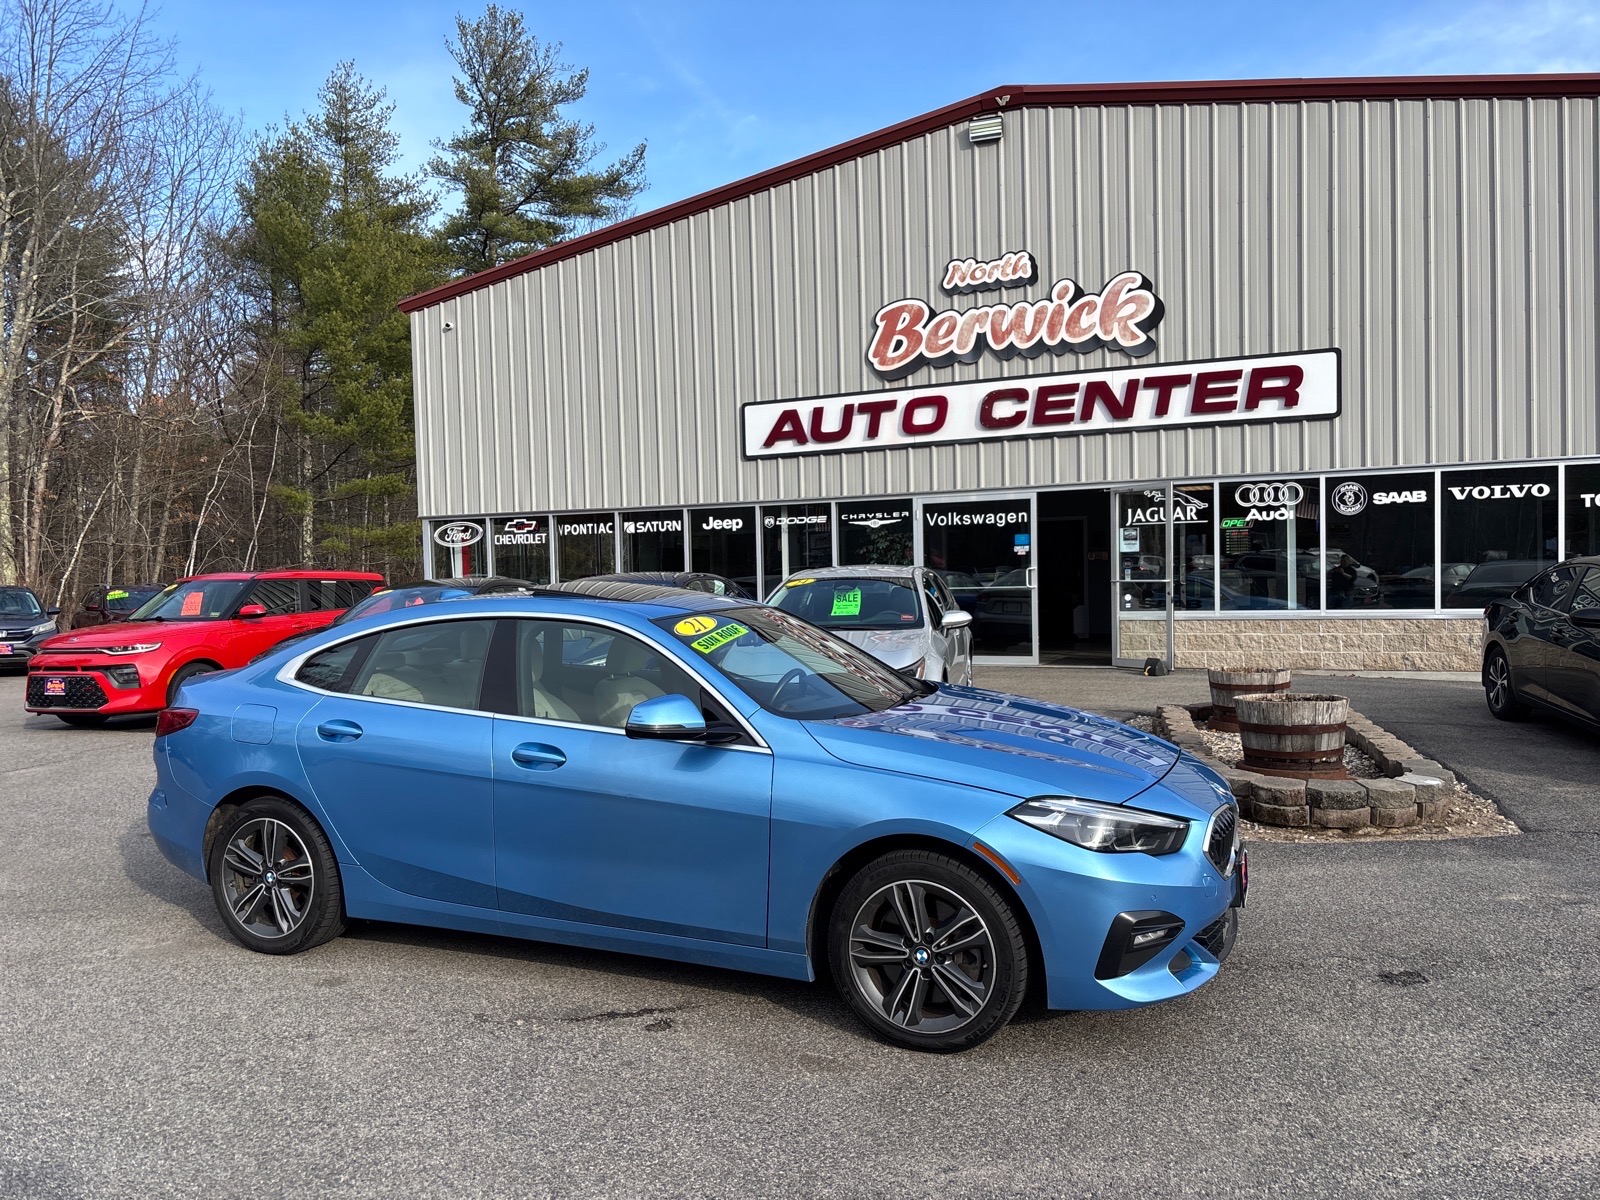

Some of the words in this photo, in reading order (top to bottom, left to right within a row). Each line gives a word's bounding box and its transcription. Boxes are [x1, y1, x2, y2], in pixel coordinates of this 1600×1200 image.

[943, 251, 1032, 291] North
[869, 271, 1152, 372] Berwick
[762, 395, 949, 447] AUTO
[980, 364, 1304, 429] CENTER
[1372, 490, 1427, 505] SAAB
[1448, 483, 1550, 500] VOLVO
[776, 515, 828, 525] DODGE
[841, 511, 909, 520] CHRYSLER
[926, 511, 1028, 527] Volkswagen
[1245, 507, 1294, 521] Audi
[564, 522, 613, 536] PONTIAC
[636, 520, 682, 533] SATURN
[702, 516, 743, 531] Jeep
[444, 526, 472, 541] Ford
[494, 533, 547, 545] CHEVROLET
[836, 593, 859, 603] SALE
[684, 618, 708, 634] 21
[697, 634, 721, 650] SUN
[715, 624, 741, 640] ROOF
